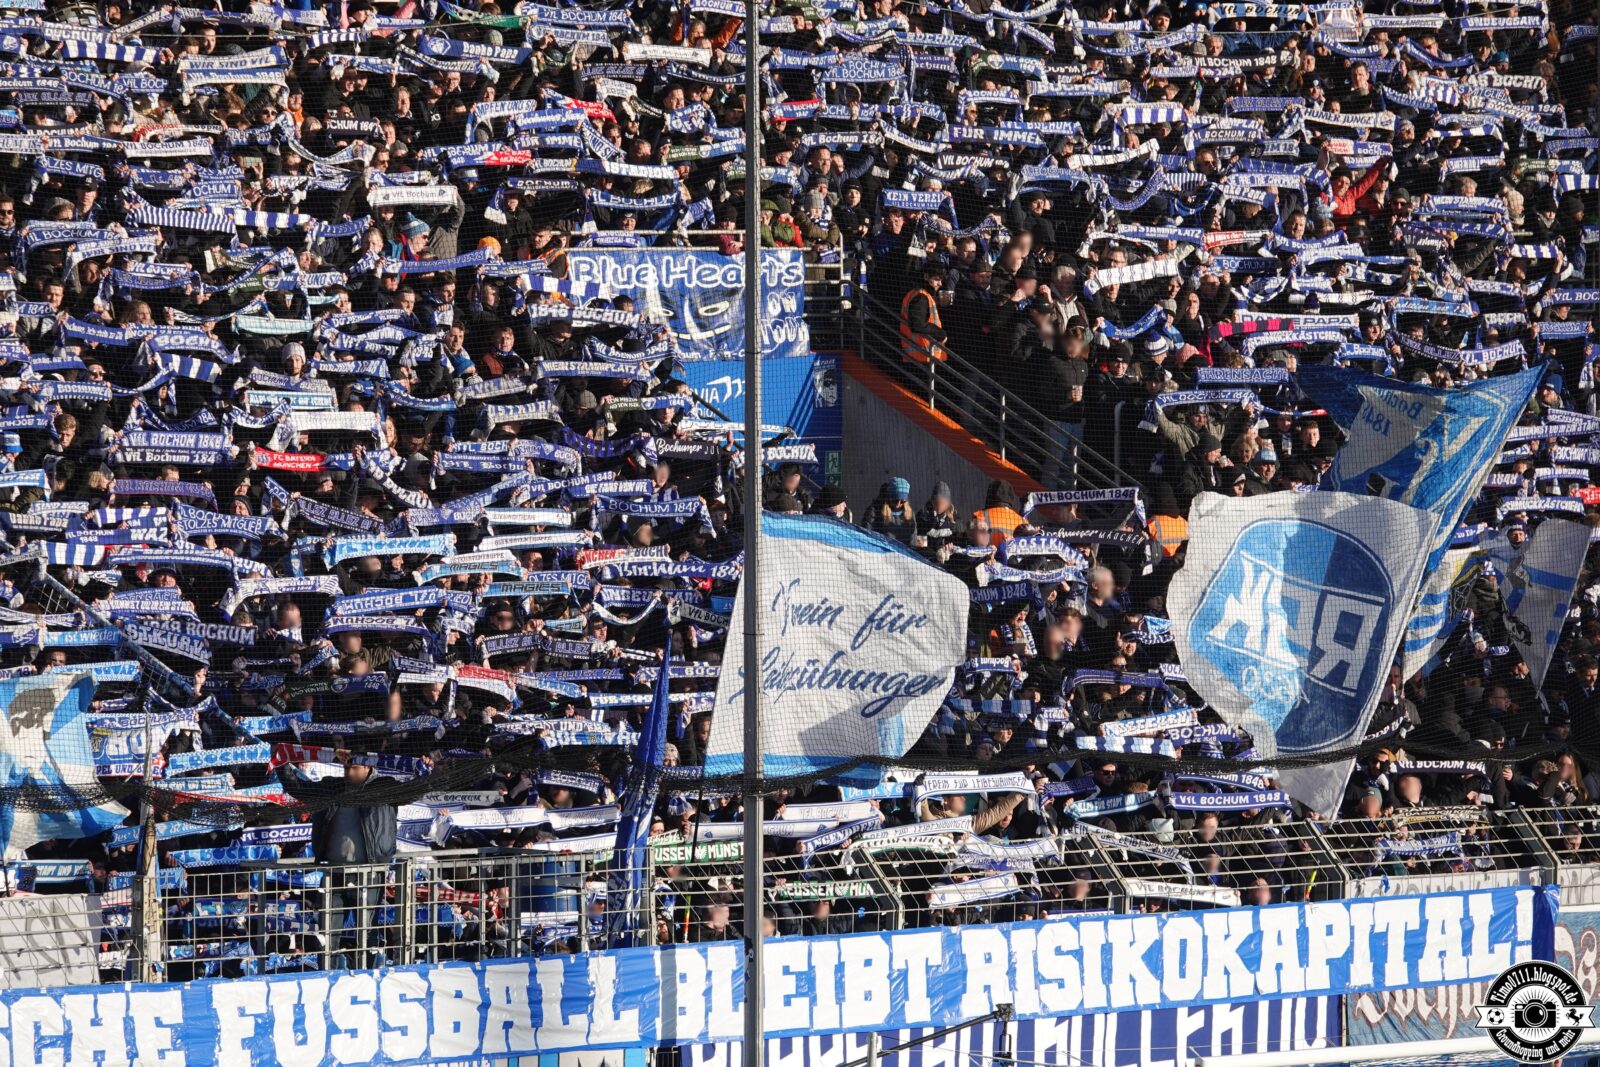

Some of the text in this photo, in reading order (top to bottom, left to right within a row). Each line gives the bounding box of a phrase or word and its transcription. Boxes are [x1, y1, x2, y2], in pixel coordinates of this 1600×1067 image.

[140, 78, 168, 89] BOCH
[606, 162, 674, 178] STADION
[193, 184, 231, 196] OCHUM
[915, 192, 945, 202] VEREI
[571, 255, 805, 289] Blue Heats
[1575, 290, 1600, 301] BOC
[480, 442, 508, 452] BOCH
[634, 546, 669, 557] BOCHU
[704, 611, 730, 626] BOCH
[850, 592, 928, 651] für
[1201, 795, 1249, 805] BOCHUM
[1253, 792, 1280, 803] 1848
[655, 842, 744, 861] USSEN MÜNST
[0, 991, 187, 1067] CHE
[212, 955, 639, 1067] FUSSBALL
[654, 931, 942, 1042] BLEIBT
[961, 889, 1535, 1018] RISIKOKAPITAL!
